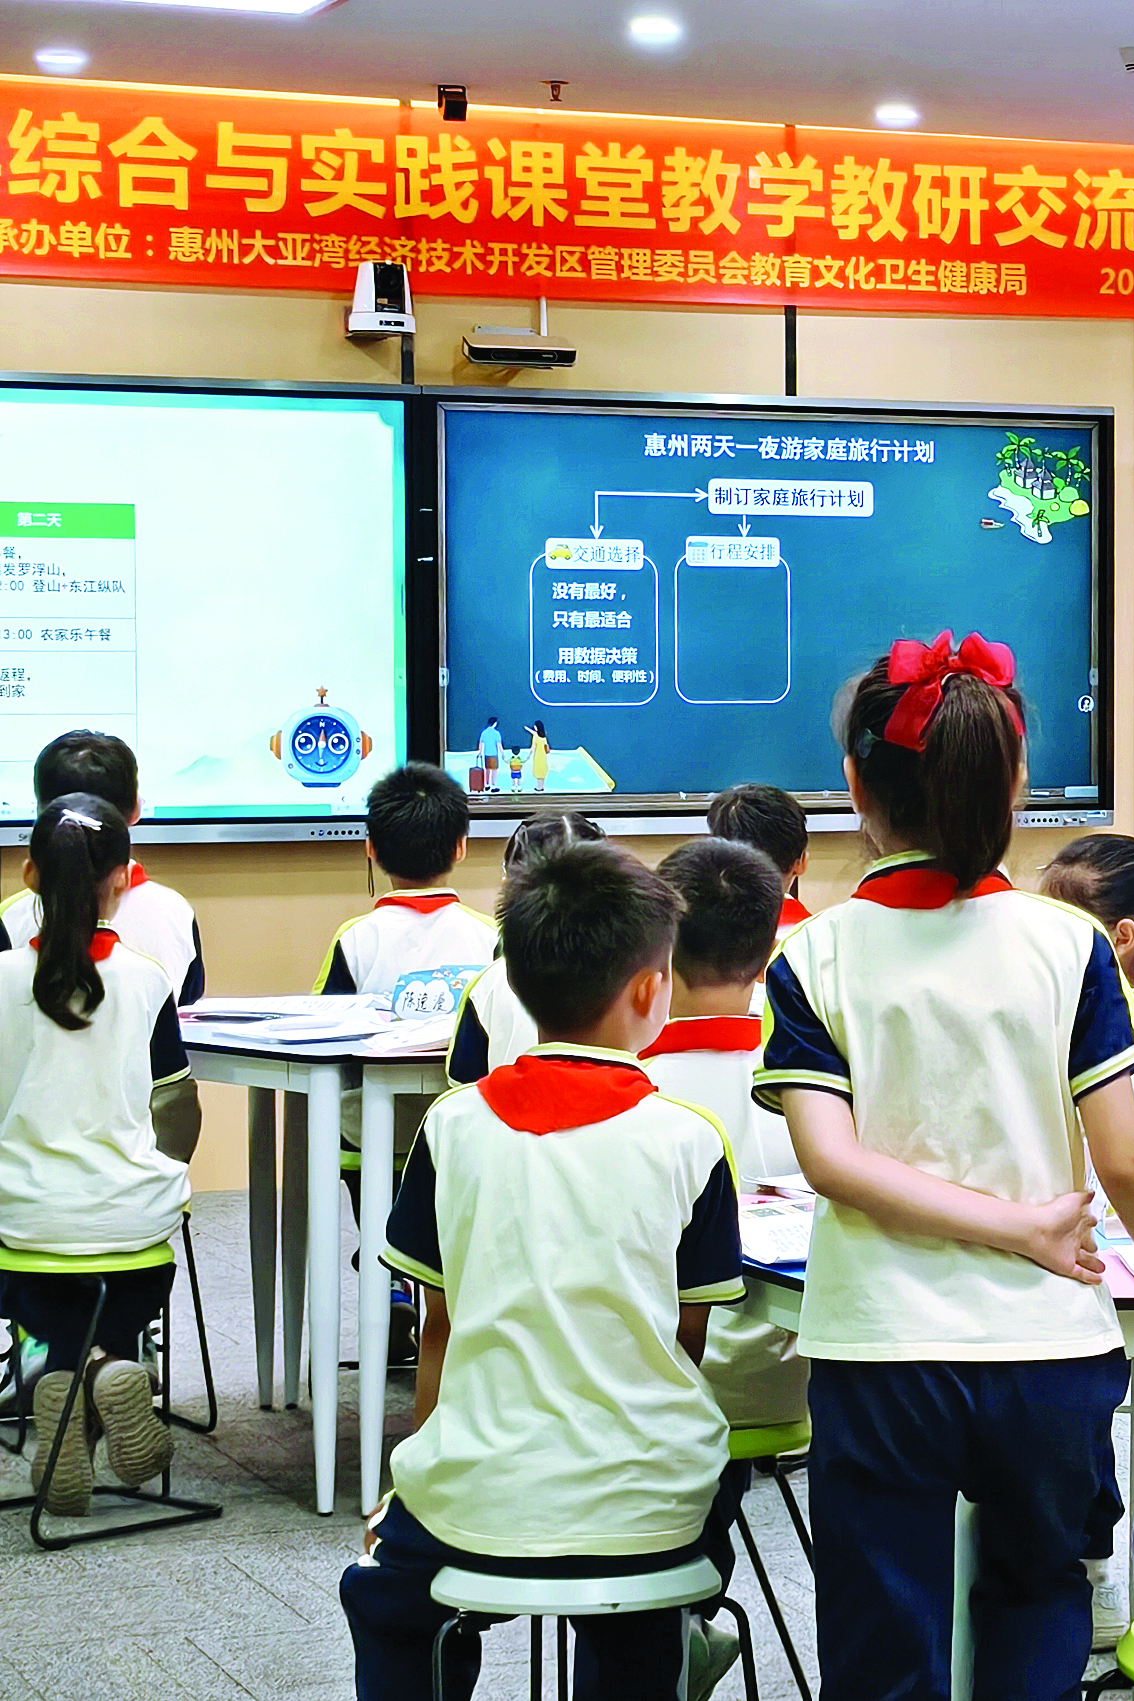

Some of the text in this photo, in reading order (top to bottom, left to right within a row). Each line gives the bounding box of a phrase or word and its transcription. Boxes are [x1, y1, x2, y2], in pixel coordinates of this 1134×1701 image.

[644, 433, 935, 464] 惠州两天一夜游家庭旅行计划
[714, 487, 865, 508] 制订家庭旅行计划
[17, 511, 62, 528] 第二天
[573, 542, 775, 564] 交通选择 行程安排
[552, 610, 632, 629] 只有最适合
[41, 628, 112, 642] 农家乐午餐
[558, 646, 638, 665] 用数据决策
